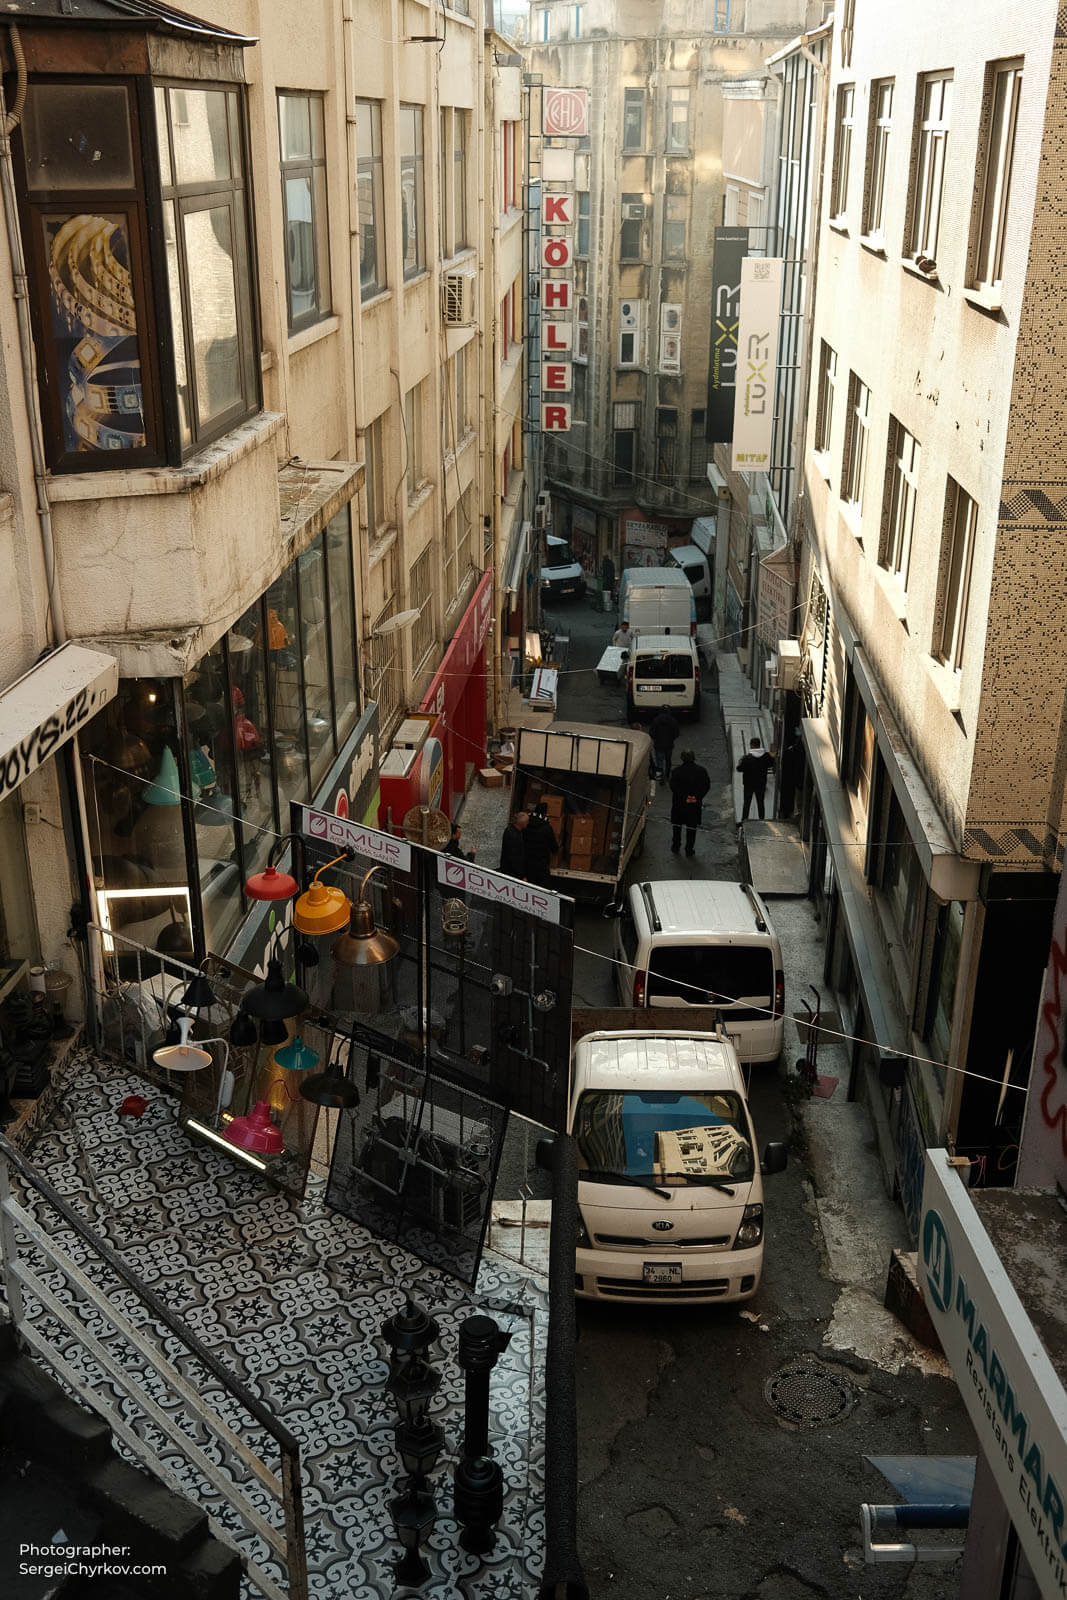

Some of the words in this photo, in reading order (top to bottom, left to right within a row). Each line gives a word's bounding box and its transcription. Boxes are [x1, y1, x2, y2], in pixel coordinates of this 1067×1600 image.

[544, 197, 570, 430] KÖHLER
[746, 332, 770, 414] LUXER
[329, 819, 400, 858] ÖMÜR
[468, 869, 549, 911] ÖMÜR
[655, 1222, 670, 1230] KIA
[956, 1274, 1067, 1563] MARMAR
[966, 1349, 1015, 1473] Rezistans
